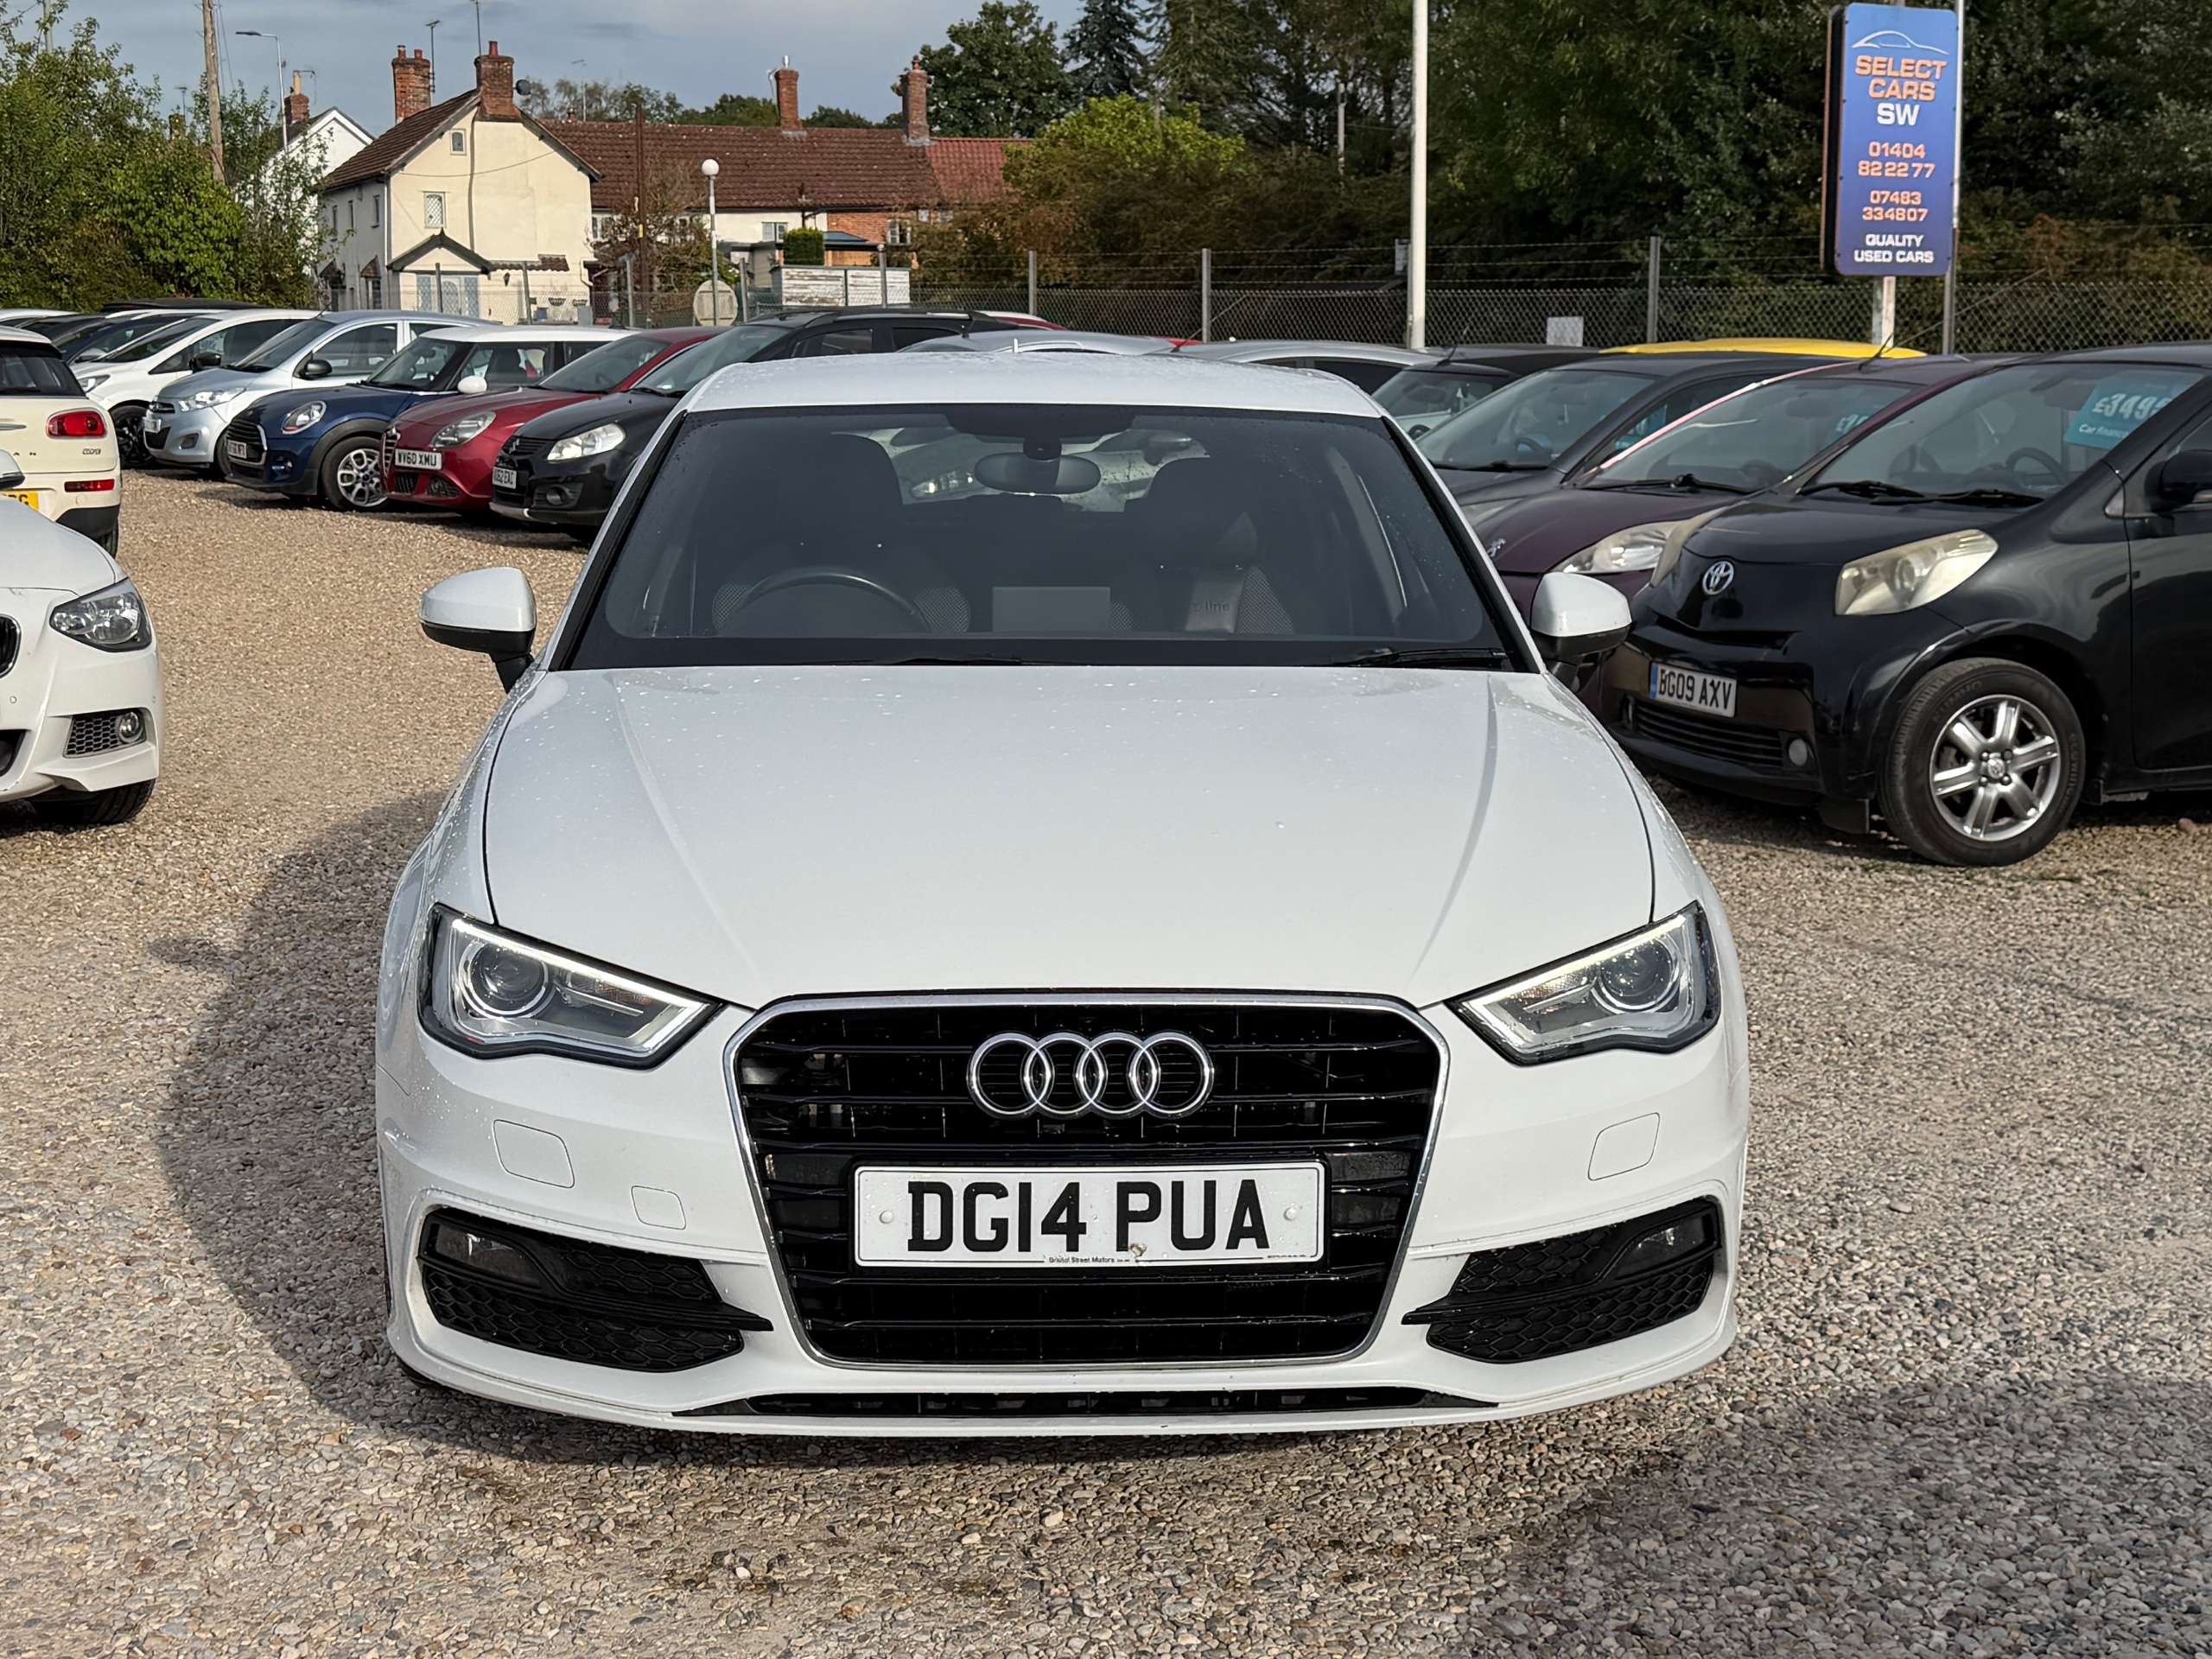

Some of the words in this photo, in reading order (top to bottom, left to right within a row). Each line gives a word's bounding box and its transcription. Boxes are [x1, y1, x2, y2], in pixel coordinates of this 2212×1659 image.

[1855, 55, 1948, 79] SELECT
[1868, 78, 1936, 101] CARS
[1877, 102, 1920, 126] SW
[1868, 141, 1926, 158] 01404
[1866, 233, 1924, 248] QUALITY
[1853, 250, 1893, 263] USED
[1895, 250, 1935, 264] CARS
[1658, 668, 1695, 702] BG09
[1698, 677, 1732, 710] AXV
[907, 1180, 1088, 1252] DG14
[1116, 1179, 1270, 1252] PUA
